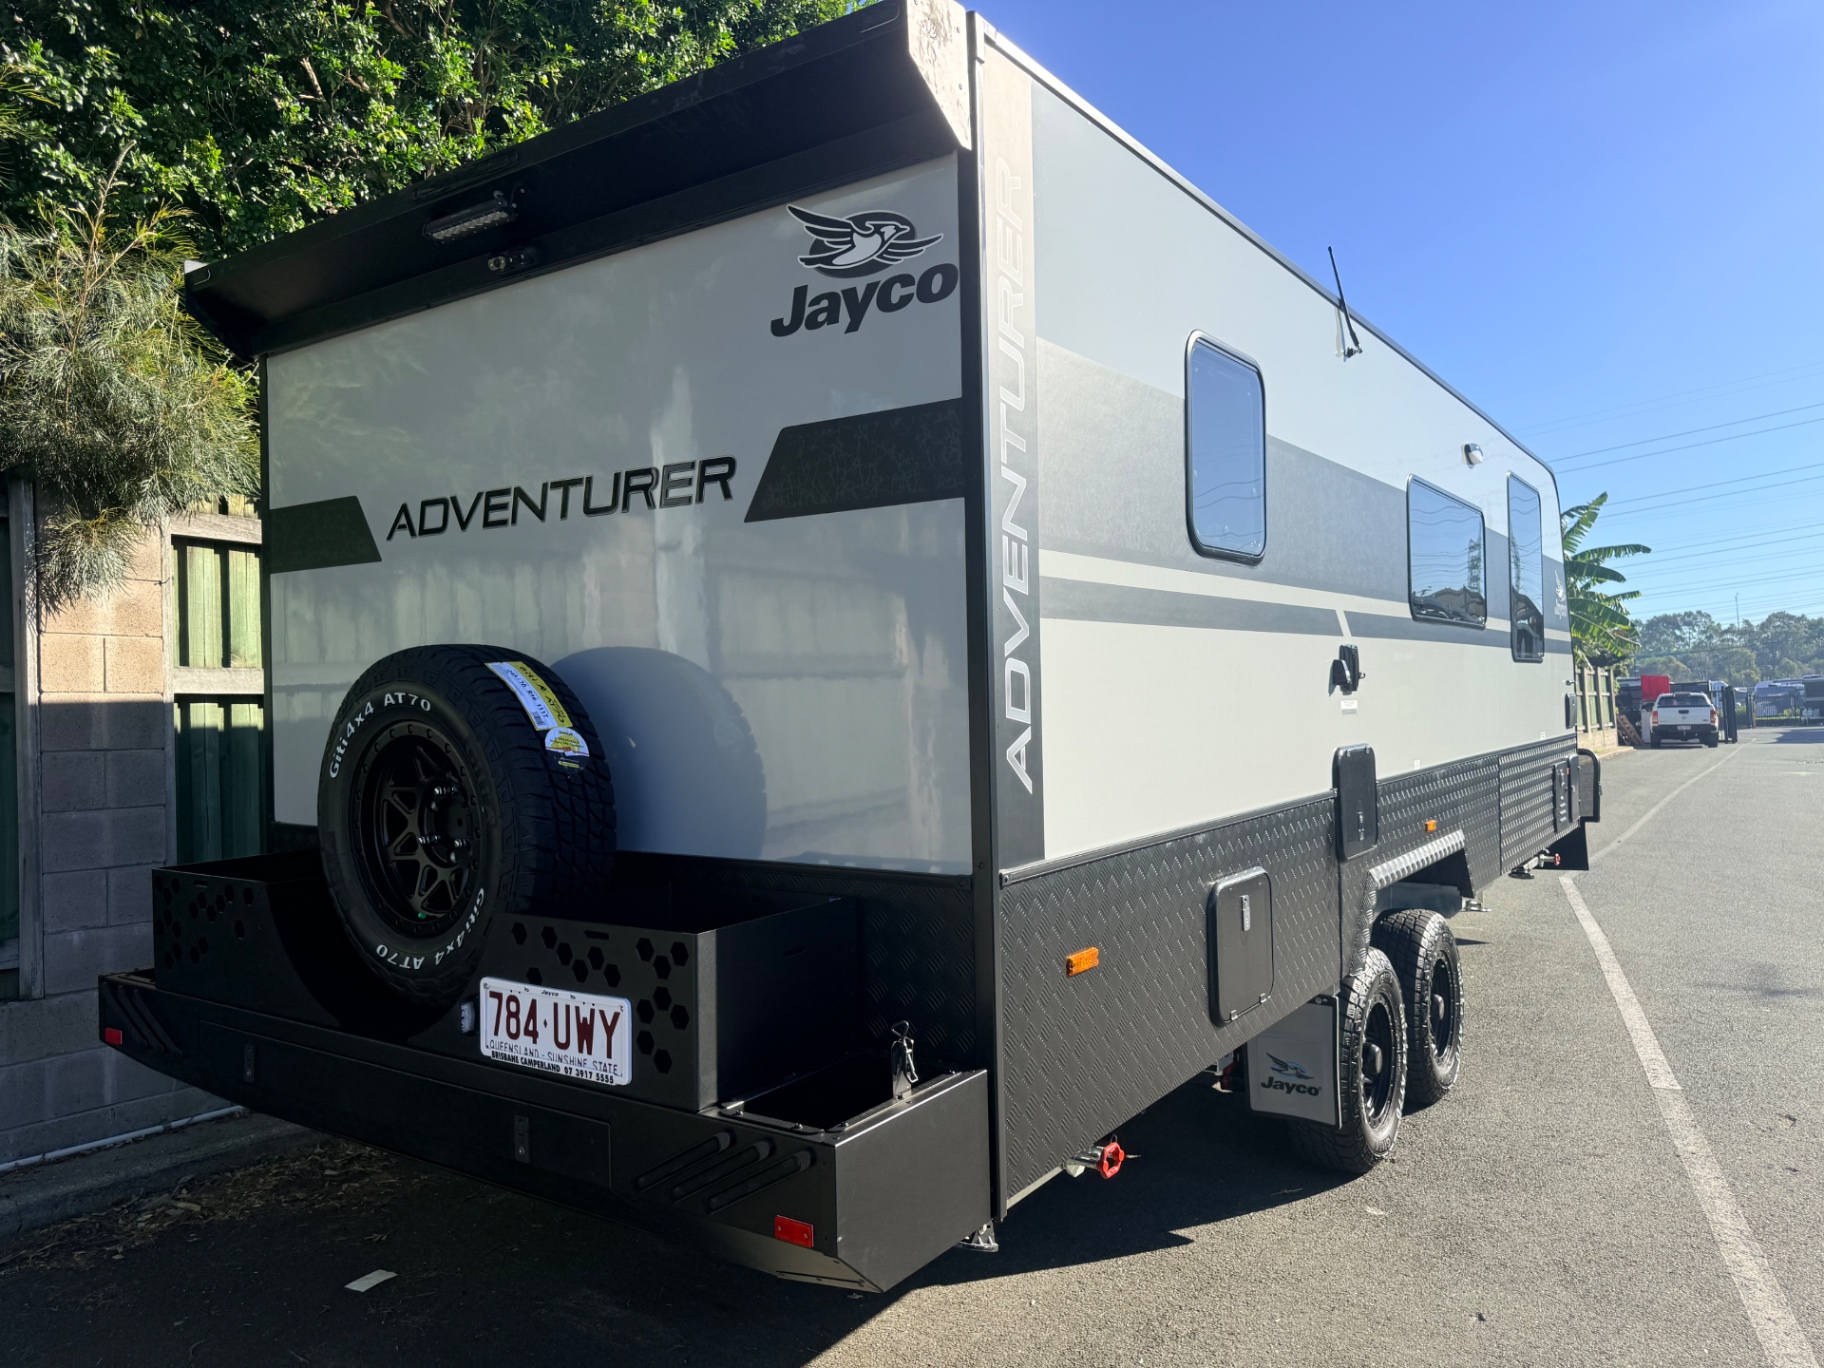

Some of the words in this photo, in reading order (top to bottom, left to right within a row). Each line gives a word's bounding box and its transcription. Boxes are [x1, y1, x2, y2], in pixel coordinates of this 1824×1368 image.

[770, 262, 959, 338] Jayco
[386, 455, 737, 542] ADVENTURER
[995, 156, 1033, 795] ADVENTURER
[329, 701, 375, 778] Giti4x4
[384, 692, 431, 711] AT70
[376, 944, 425, 969] AT70
[435, 888, 485, 965] Giti4x4
[489, 990, 539, 1045] 784
[553, 1002, 621, 1060] UWY
[541, 989, 559, 997] Jayco
[489, 1039, 540, 1059] QUEENSLAND
[547, 1051, 588, 1067] SUNSHINE
[592, 1060, 619, 1076] STATE
[491, 1050, 520, 1064] BRISBANE
[520, 1057, 561, 1072] CAMPERLAND
[563, 1066, 573, 1075] 07
[575, 1068, 593, 1080] 3917
[595, 1073, 614, 1084] 5555
[1260, 1076, 1321, 1097] Jayco
